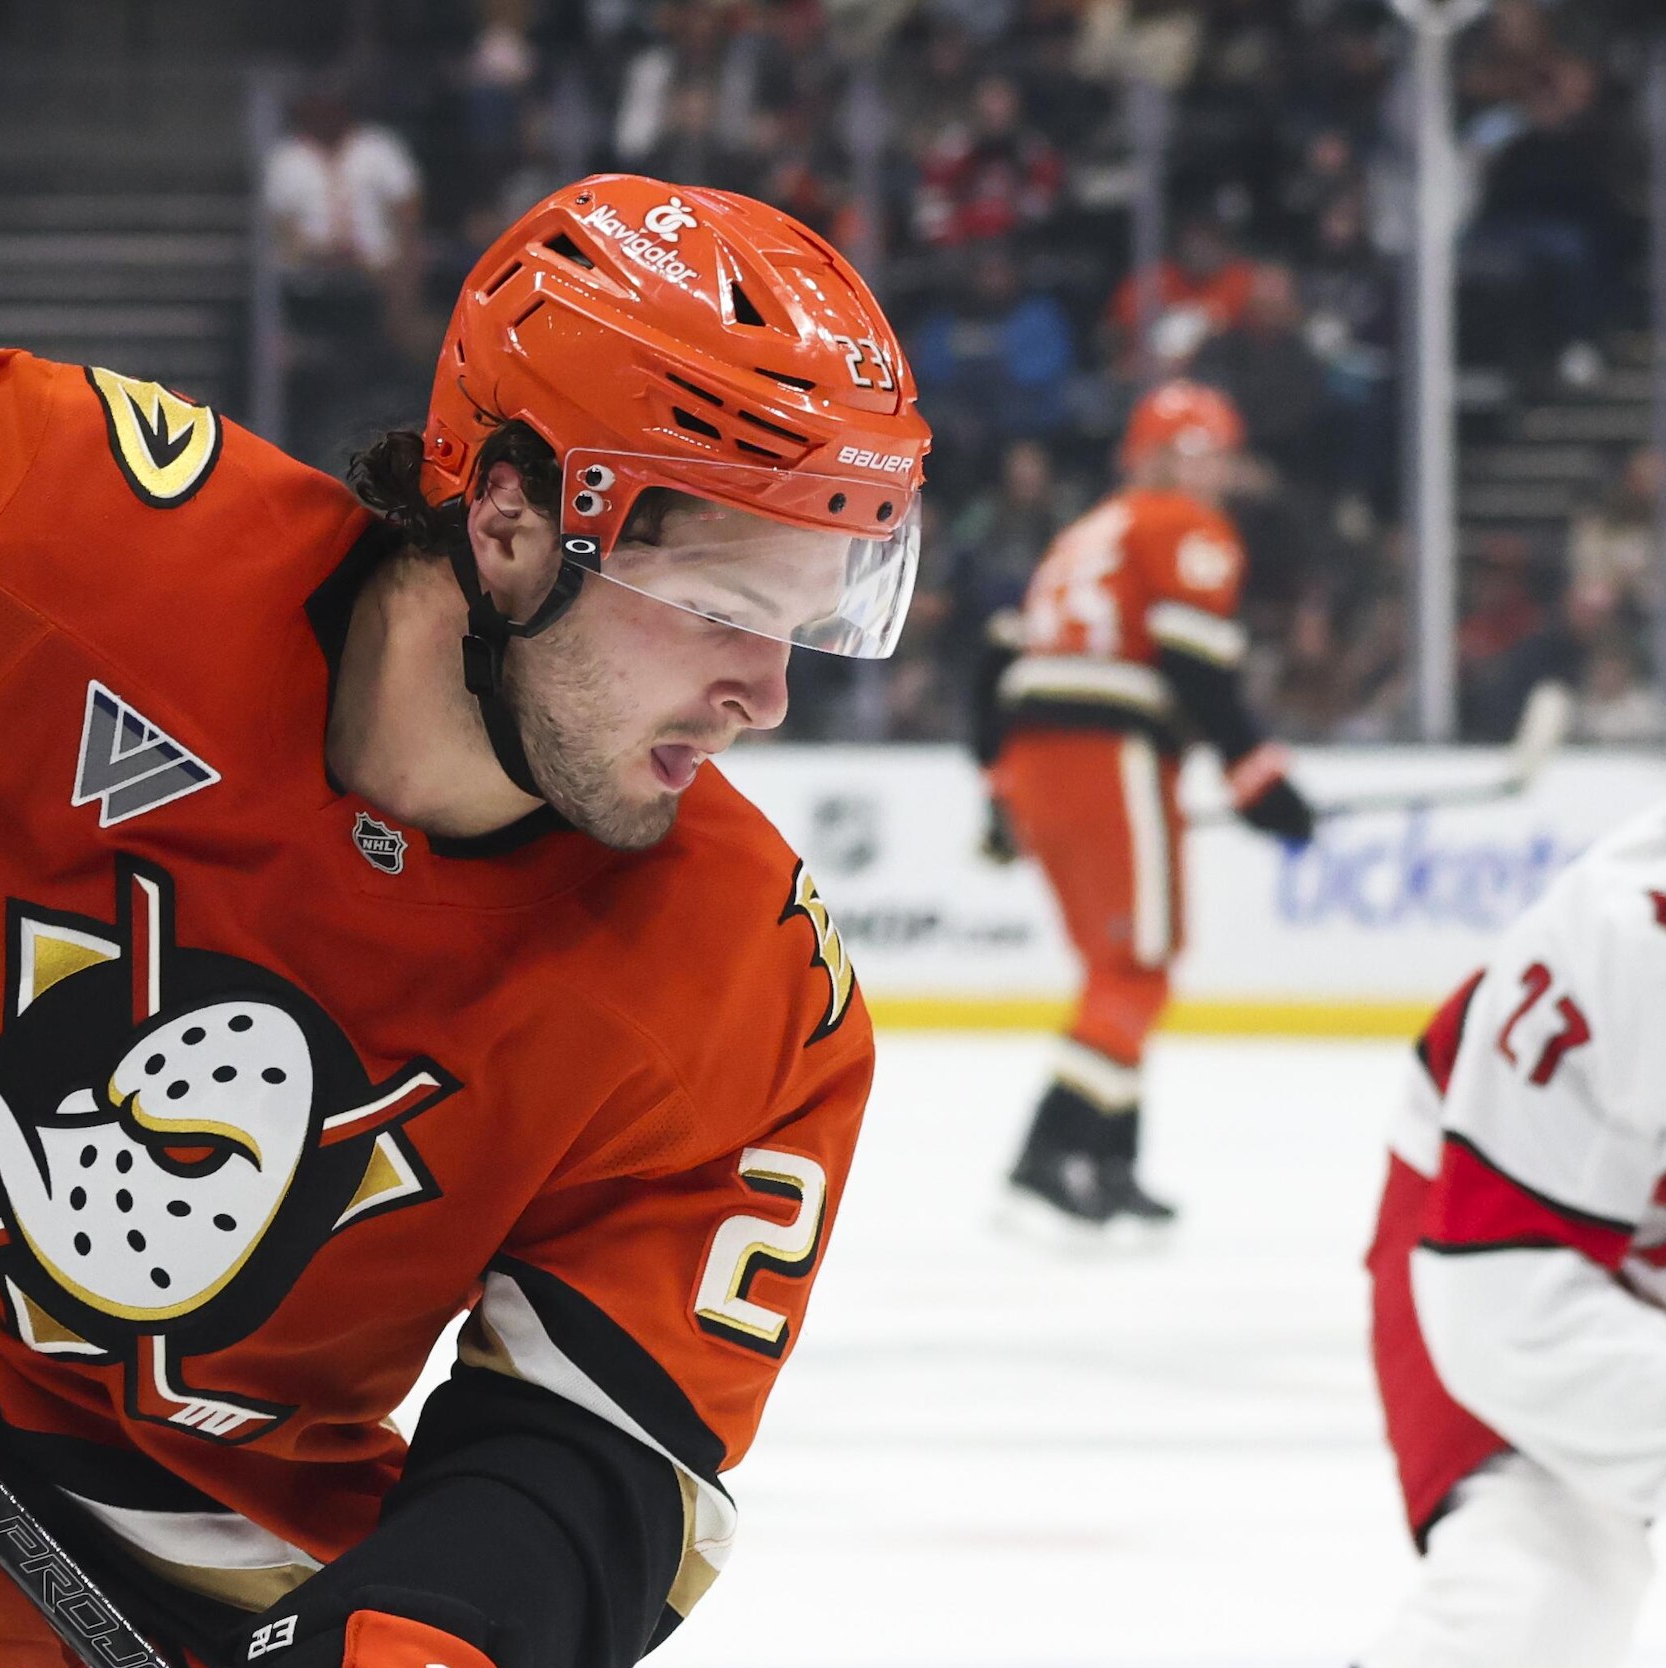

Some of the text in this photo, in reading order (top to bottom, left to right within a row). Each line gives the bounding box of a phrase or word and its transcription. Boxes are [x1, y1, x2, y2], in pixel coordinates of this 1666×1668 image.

[582, 204, 698, 283] Navigator
[834, 335, 895, 391] 23
[838, 446, 914, 473] BAUER
[363, 840, 393, 852] NHL
[1497, 961, 1592, 1086] 27
[694, 1147, 827, 1360] 2
